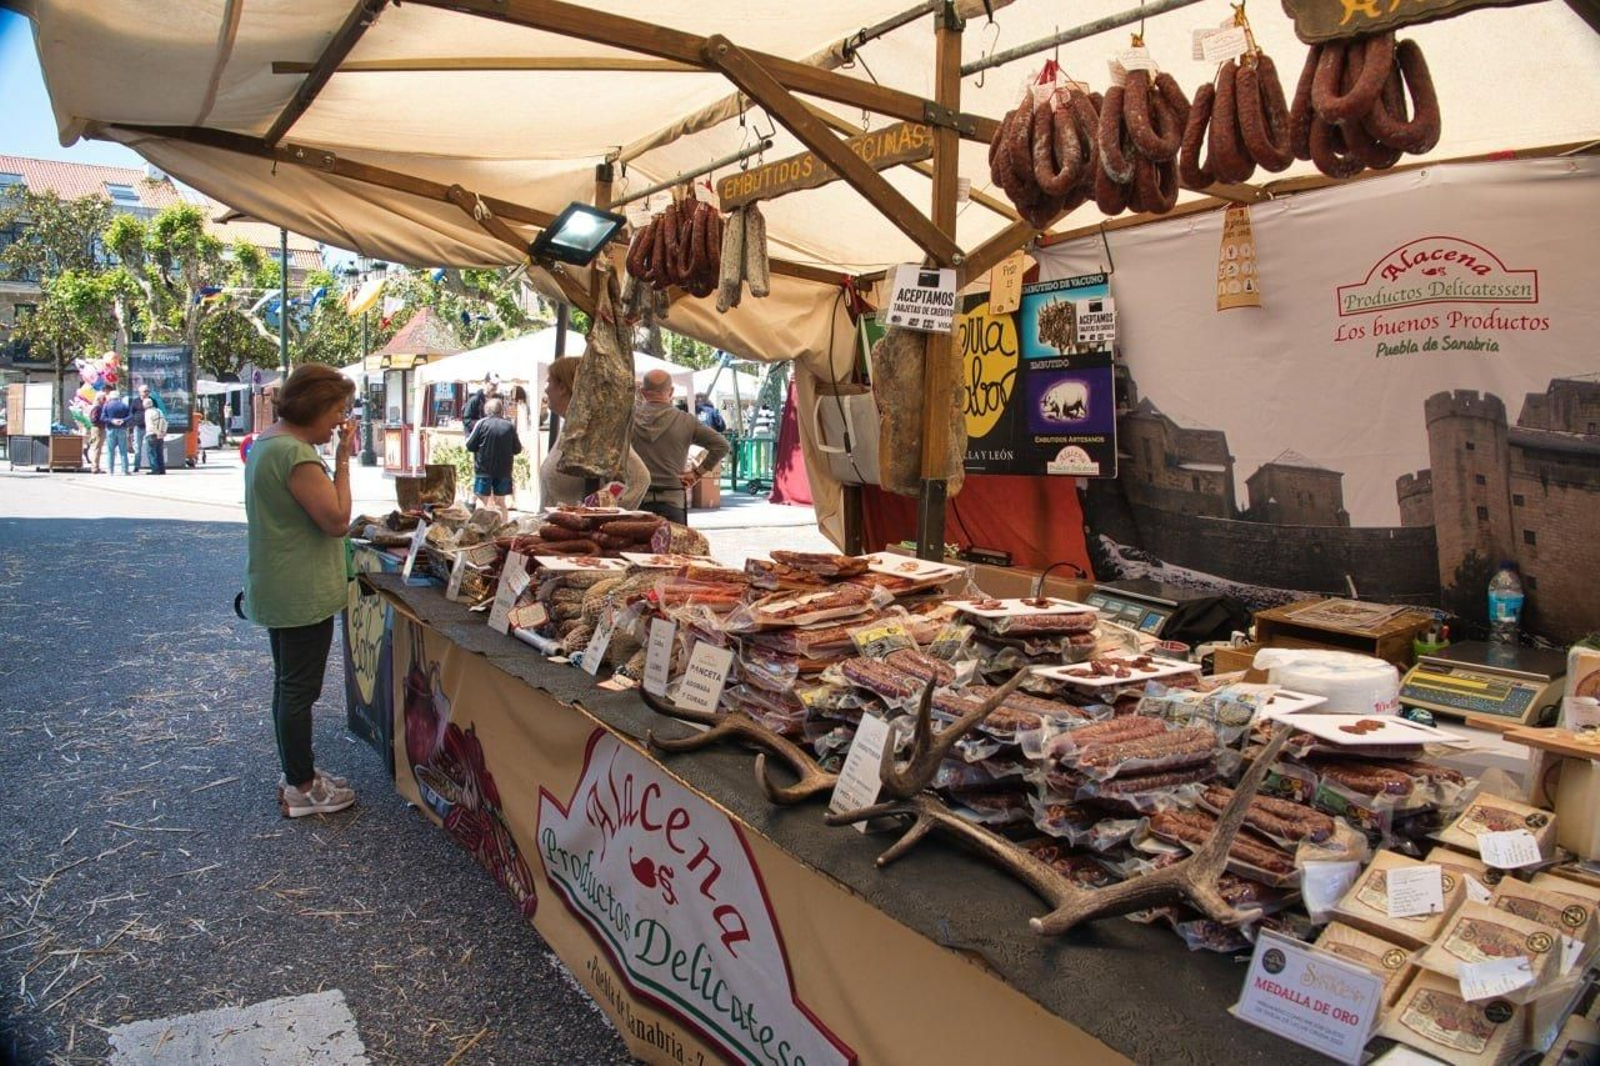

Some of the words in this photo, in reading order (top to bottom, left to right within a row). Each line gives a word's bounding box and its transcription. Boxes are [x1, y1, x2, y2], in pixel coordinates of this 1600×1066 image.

[724, 155, 813, 199] EMBUTIDOS
[852, 125, 927, 162] ECINAS
[1380, 249, 1492, 282] Alacena
[1060, 279, 1070, 288] DE
[1071, 275, 1104, 287] VACUNO
[1344, 286, 1422, 310] Productos
[1428, 277, 1532, 298] Delicatessen
[894, 303, 921, 314] TARJETAS
[922, 306, 930, 315] DE
[897, 288, 954, 306] ACEPTAMOS
[1079, 313, 1114, 325] ACEPTAMOS
[1334, 323, 1366, 342] Los
[1373, 315, 1439, 337] buenos
[1446, 308, 1550, 331] Productos
[1376, 339, 1418, 358] Puebla
[1422, 336, 1438, 351] de
[1442, 335, 1500, 352] Sanabria
[1029, 359, 1070, 370] EMBUTIDO
[989, 449, 1014, 460] LEÓN
[690, 664, 722, 683] PANCETA
[585, 744, 752, 959] Alacena
[542, 827, 632, 944] Productos
[1254, 976, 1311, 1009] MEDALLA
[1313, 1000, 1331, 1016] DE
[1332, 1007, 1360, 1027] ORO
[625, 1002, 684, 1063] Sanabria
